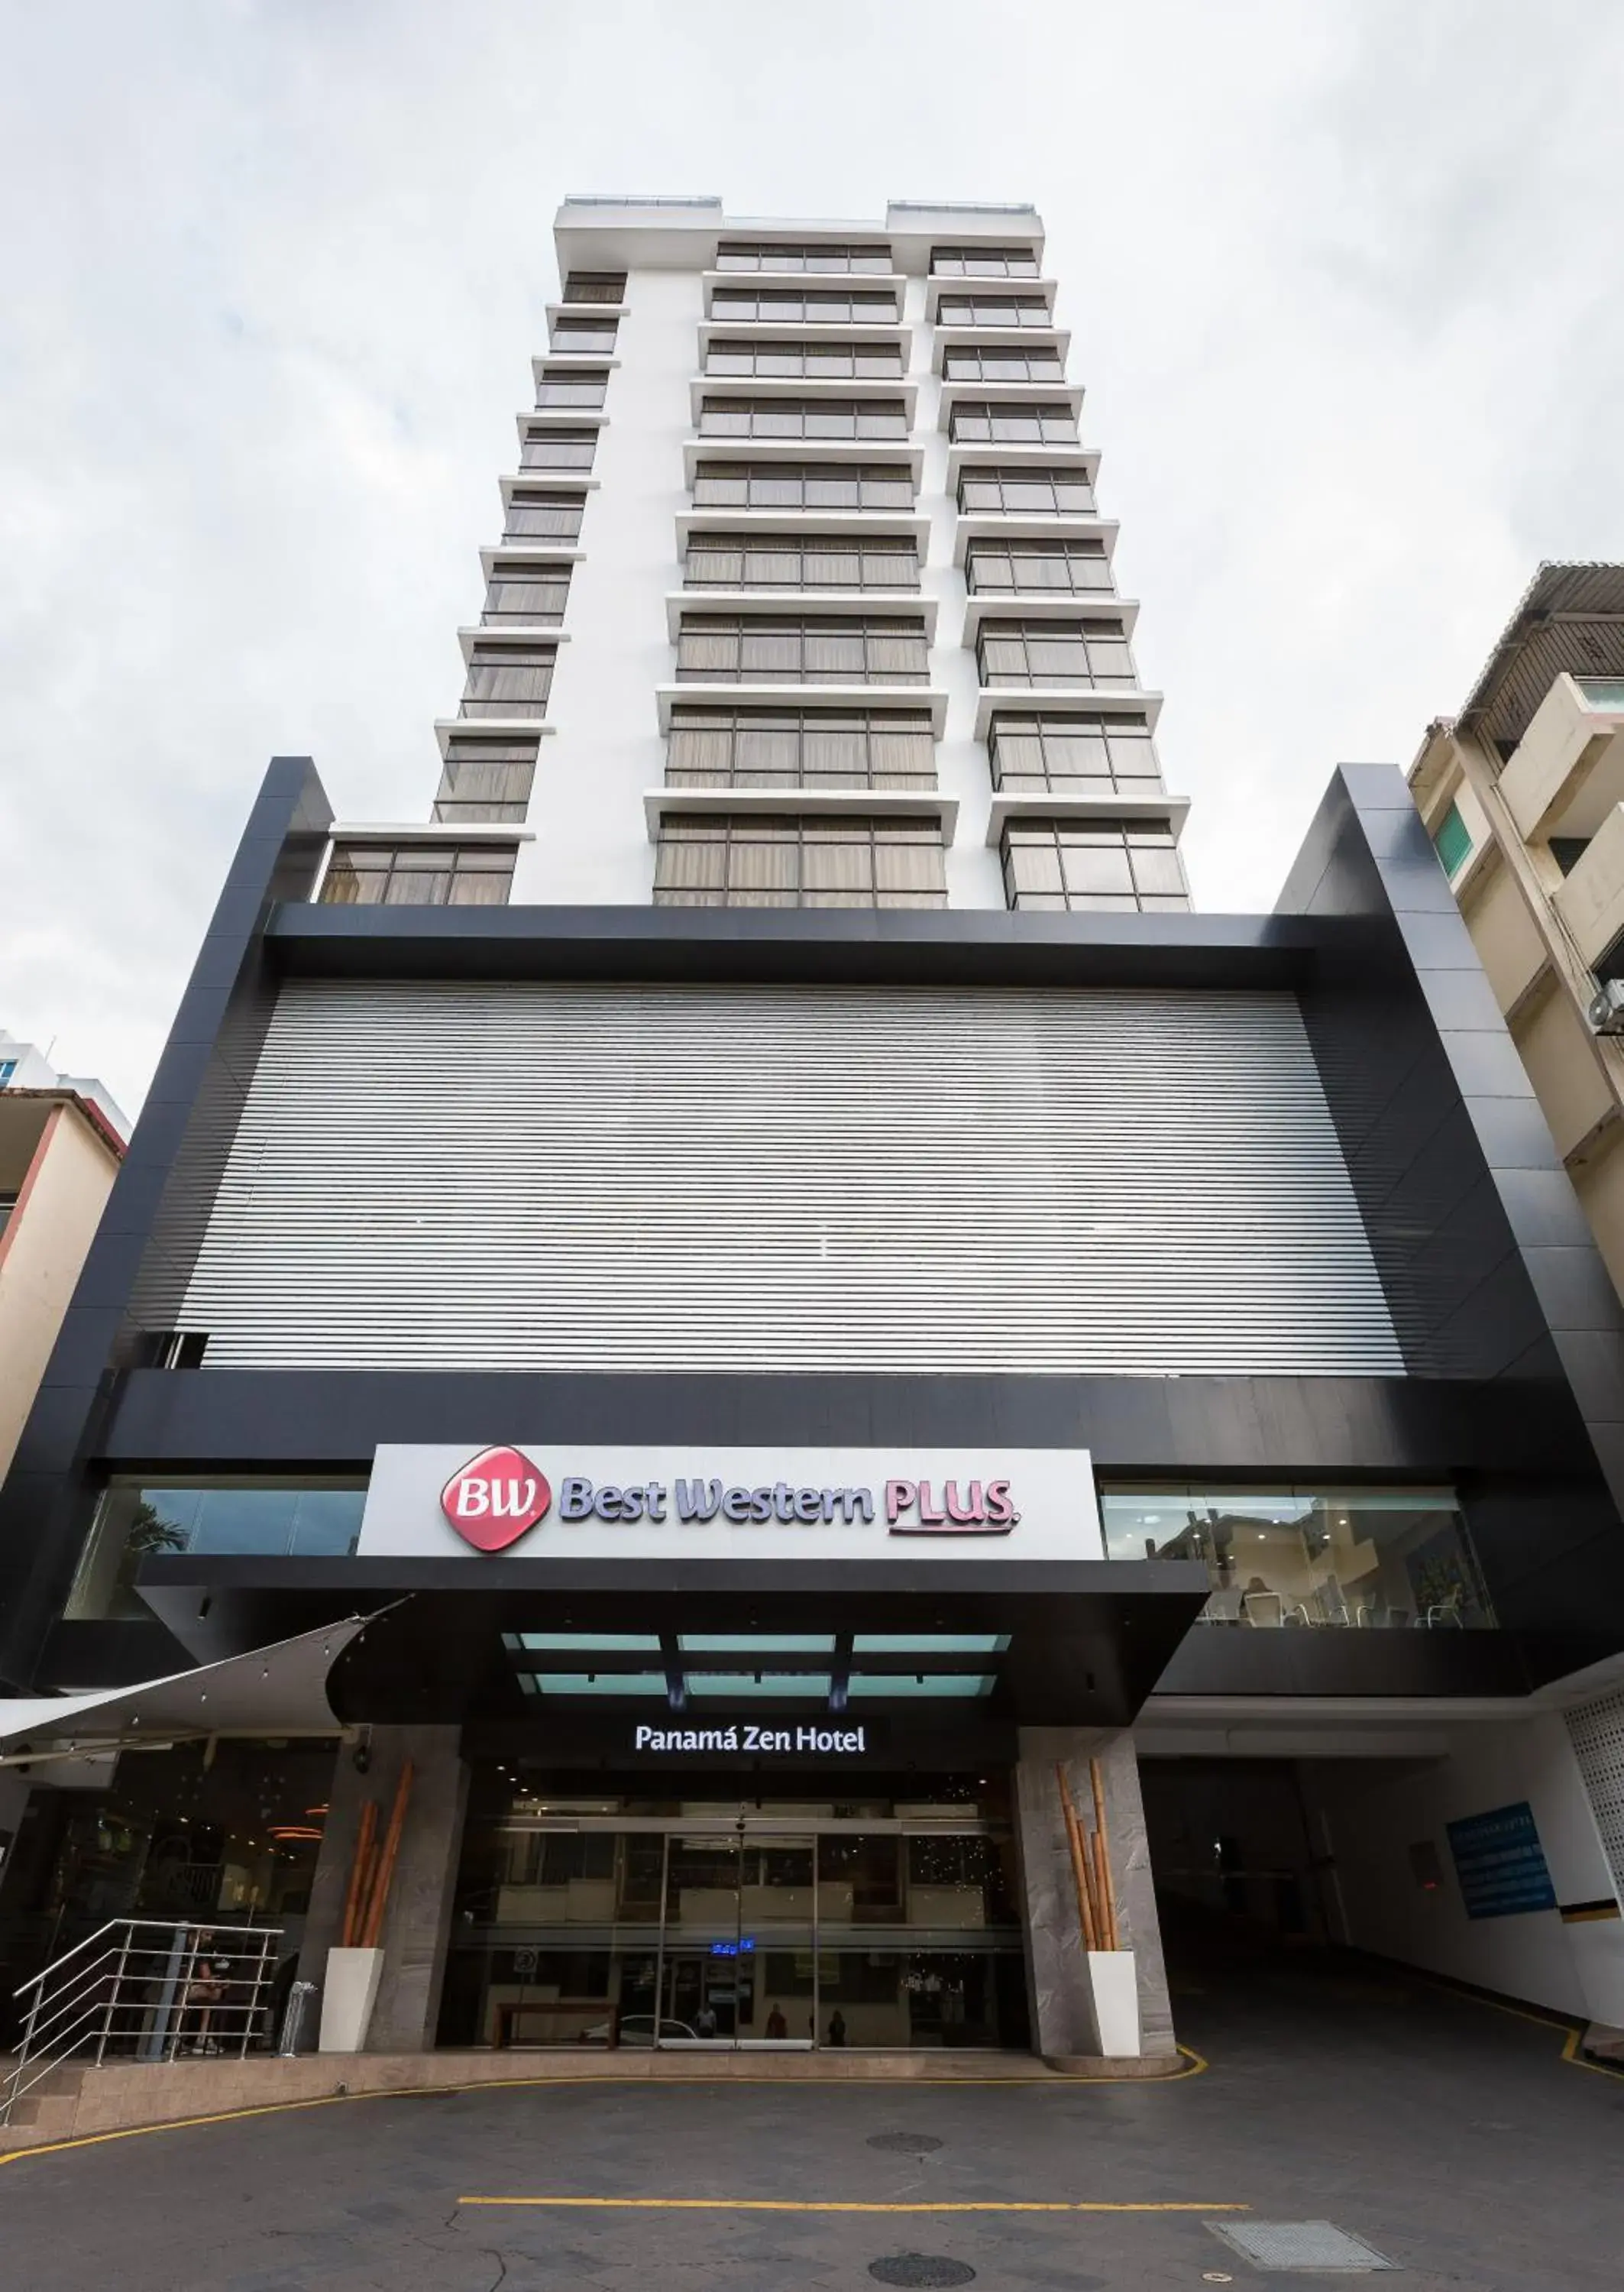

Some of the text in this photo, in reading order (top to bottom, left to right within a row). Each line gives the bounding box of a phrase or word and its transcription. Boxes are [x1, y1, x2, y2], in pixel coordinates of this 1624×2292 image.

[456, 1478, 535, 1517] BW
[559, 1476, 667, 1523] Best
[675, 1478, 876, 1524] Western
[636, 1724, 866, 1753] Panamá Zen Hotel
